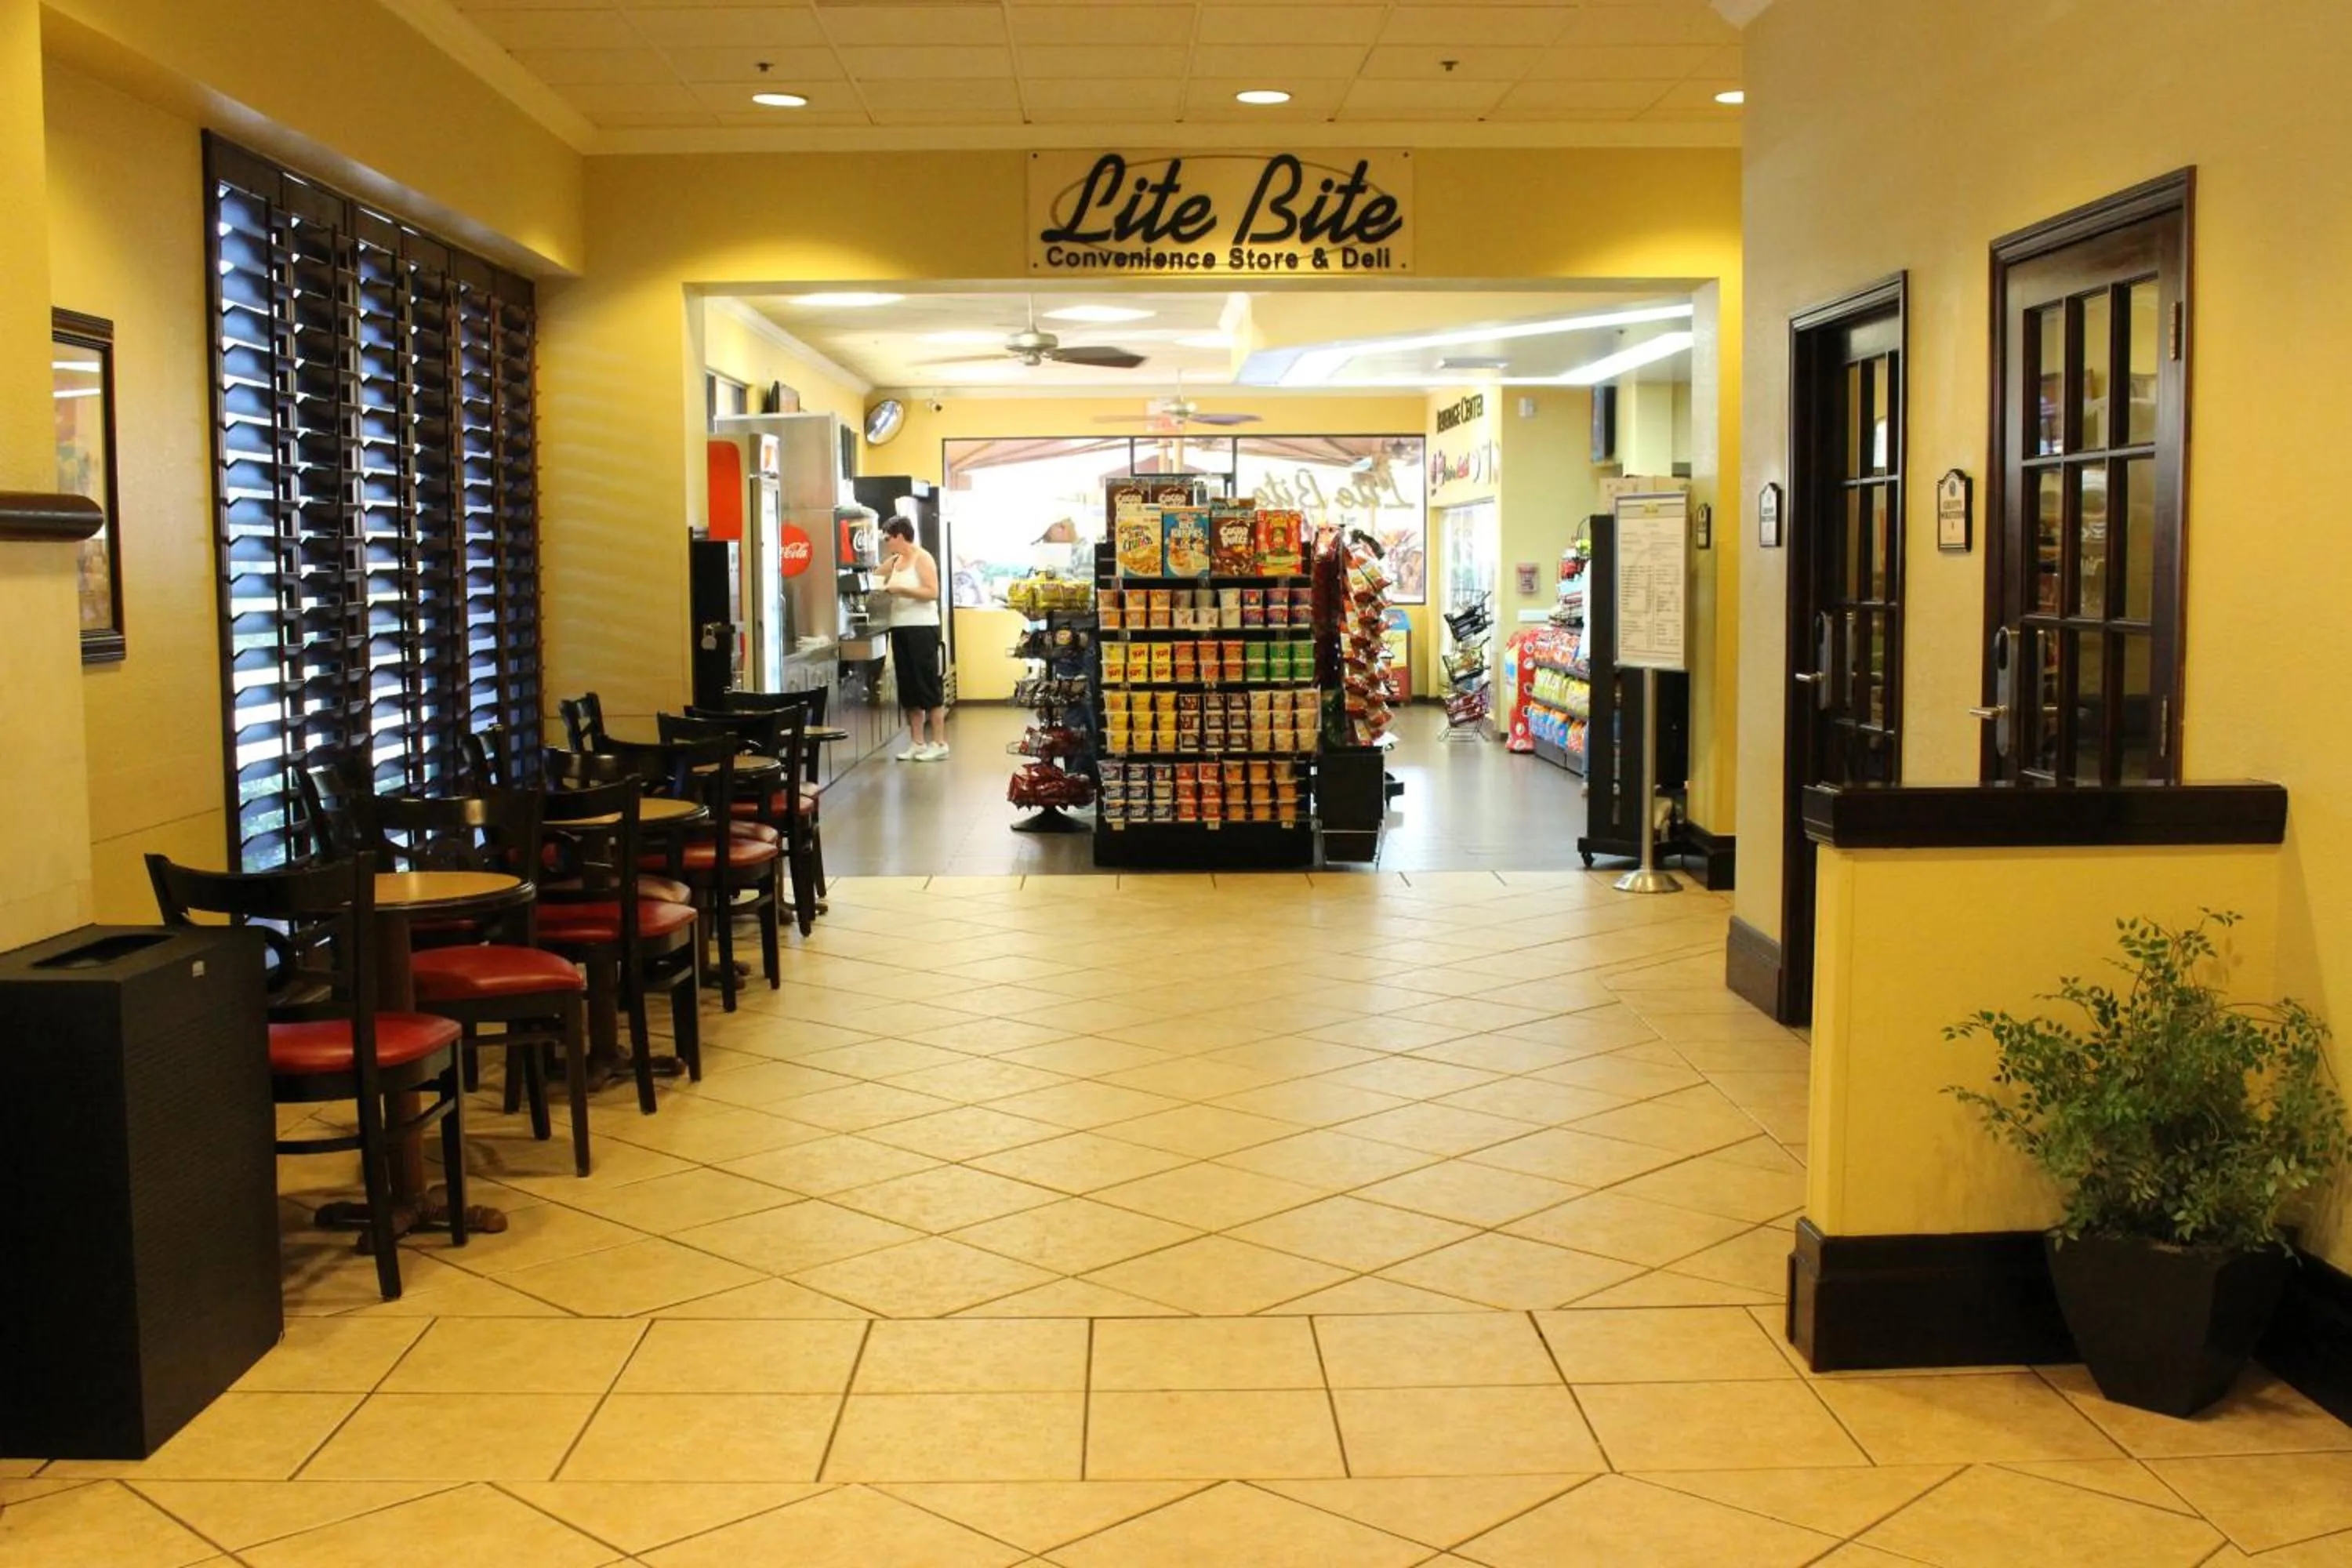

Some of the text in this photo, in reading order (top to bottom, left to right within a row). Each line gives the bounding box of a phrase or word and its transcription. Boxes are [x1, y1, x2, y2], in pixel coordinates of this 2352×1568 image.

[1041, 154, 1402, 245] Lite Bite
[1047, 247, 1391, 269] Convenience Store & Deli
